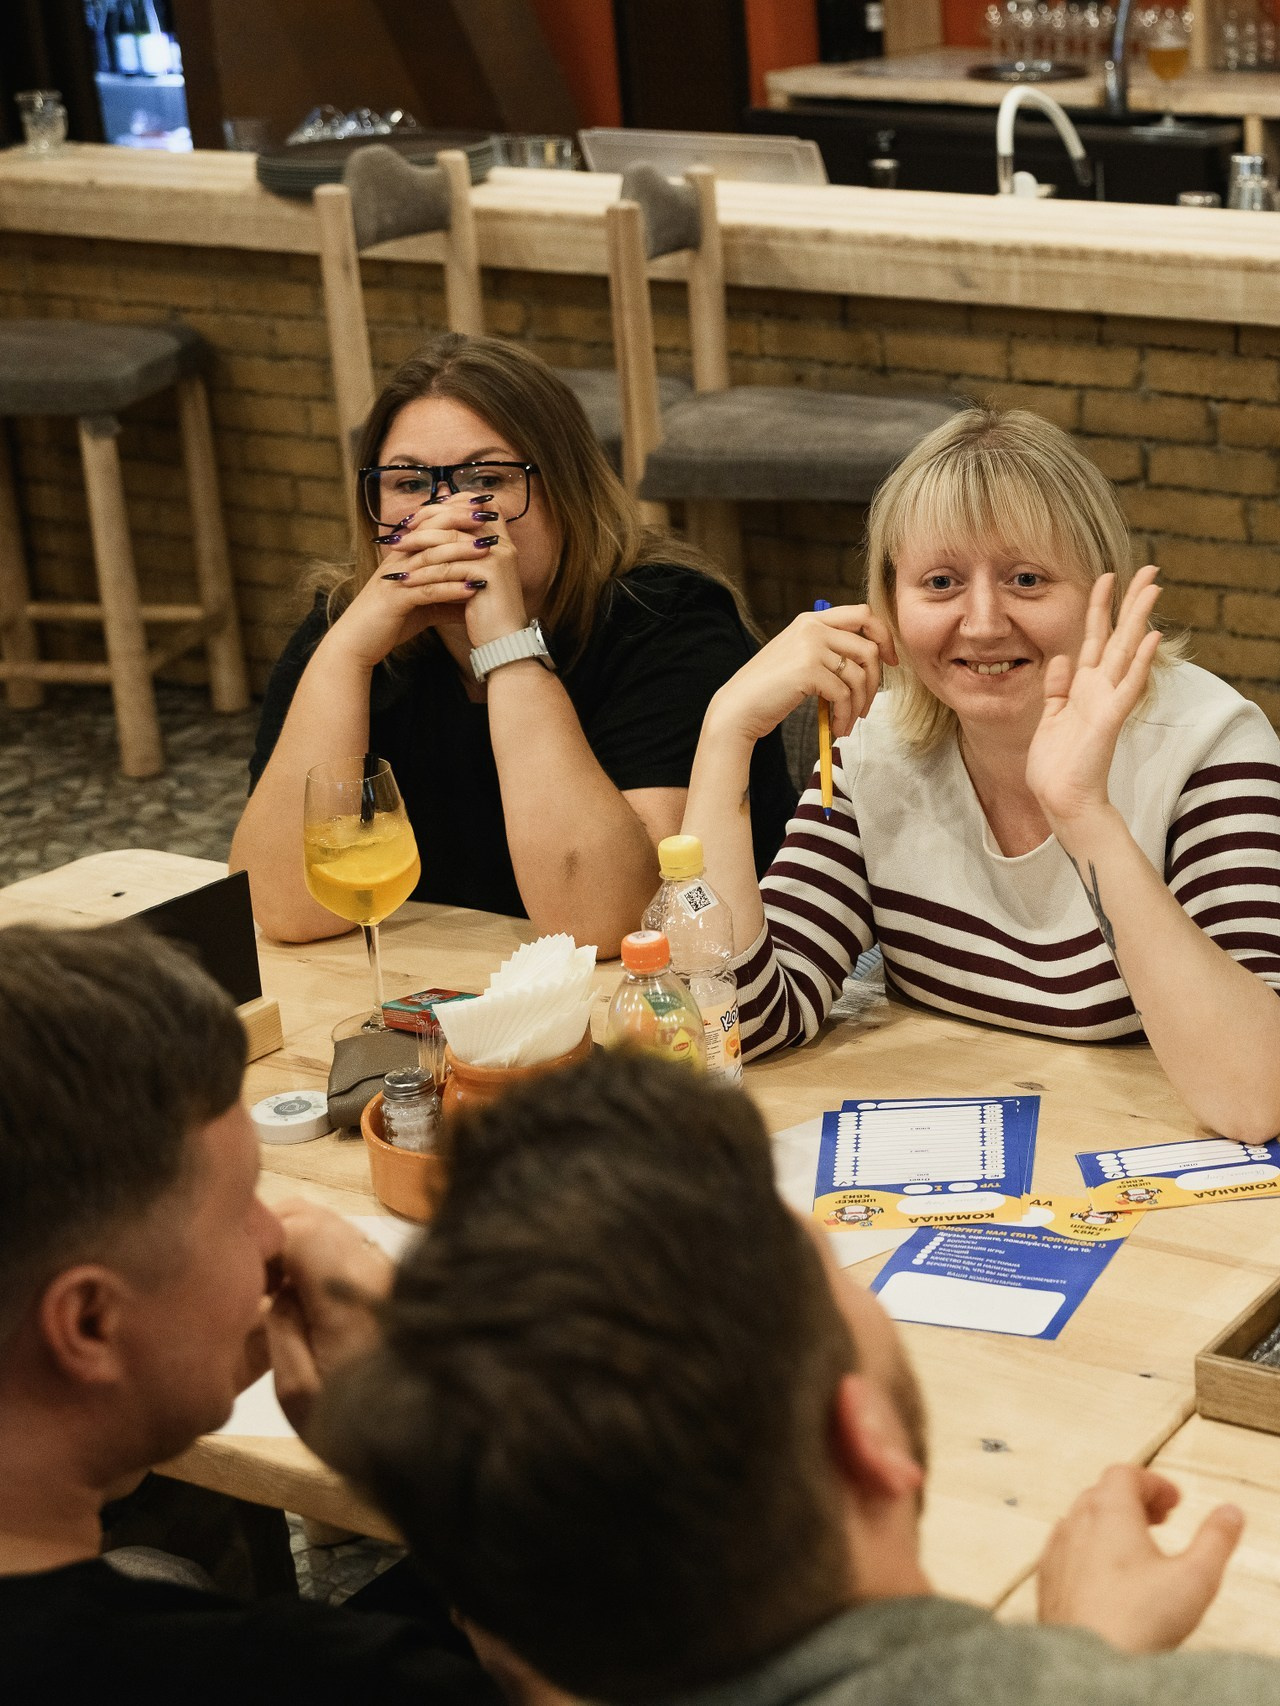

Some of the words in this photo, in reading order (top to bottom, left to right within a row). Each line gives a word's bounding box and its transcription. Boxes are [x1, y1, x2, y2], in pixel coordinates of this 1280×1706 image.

[1193, 1181, 1278, 1199] КОМАНДА
[909, 1212, 995, 1224] КОМАНДА
[932, 1225, 984, 1235] ПОМОГИТЕ
[1010, 1232, 1038, 1240] СТАТЬ
[1042, 1236, 1096, 1248] ТОПЧИКОМ
[1070, 1223, 1111, 1232] ШЕЙКЕР
[937, 1231, 967, 1240] Друзья,
[1003, 1239, 1051, 1249] пожалуйста,
